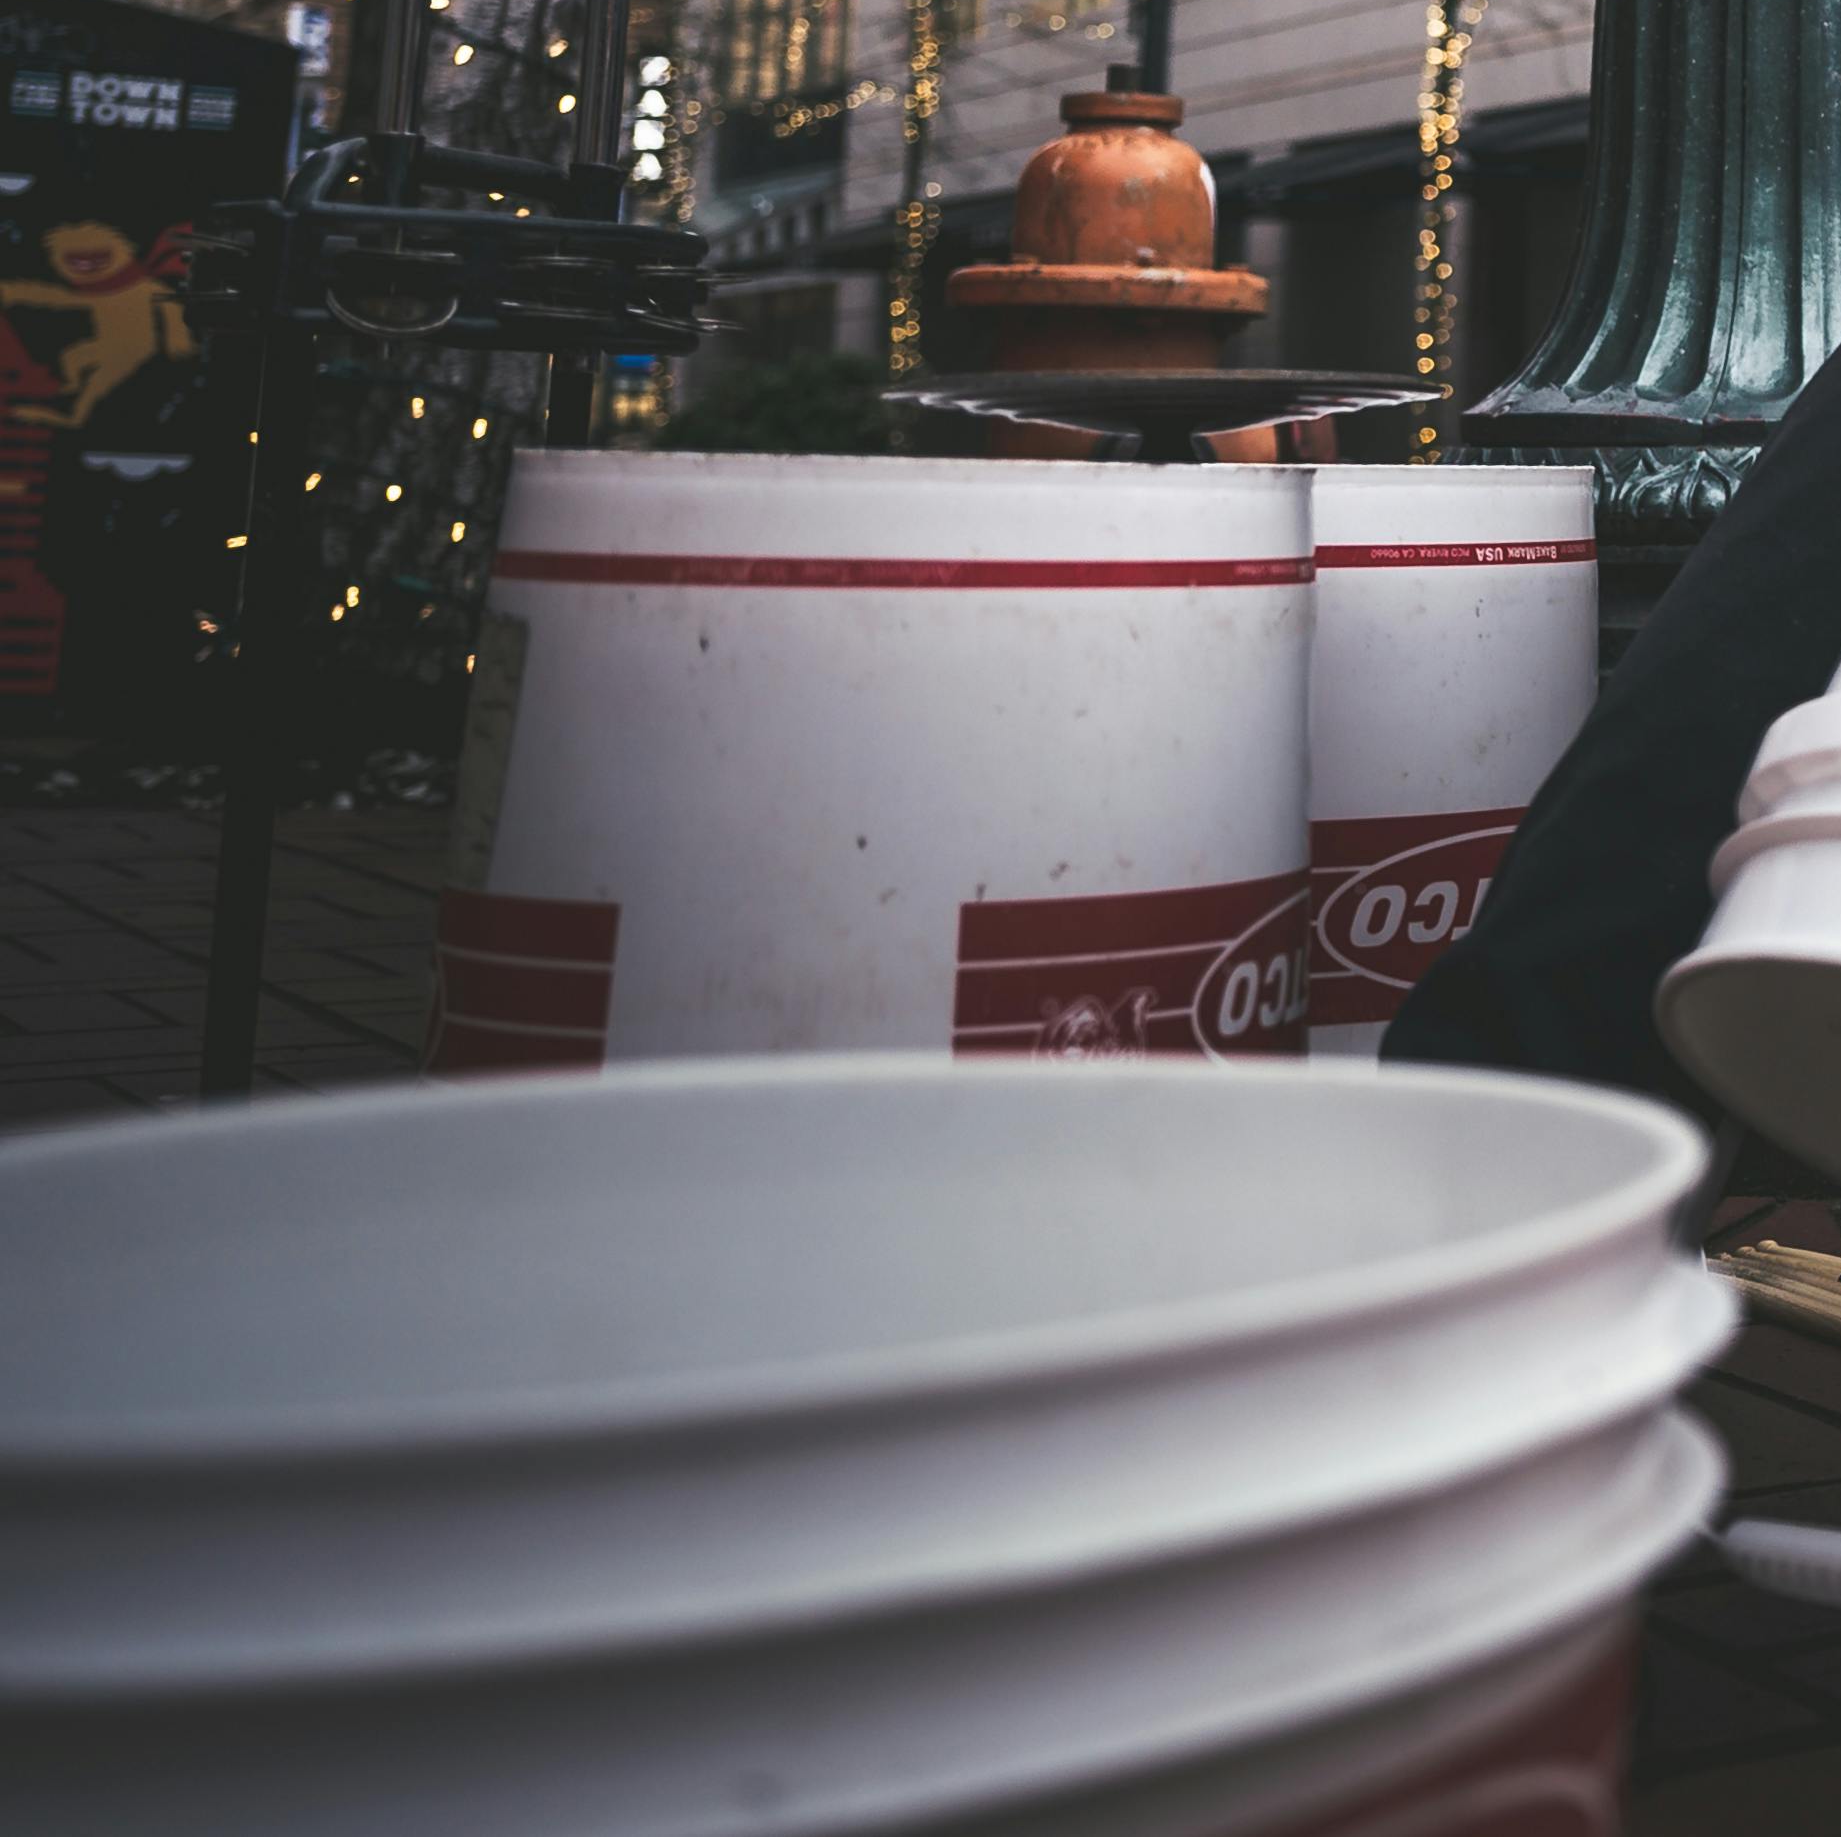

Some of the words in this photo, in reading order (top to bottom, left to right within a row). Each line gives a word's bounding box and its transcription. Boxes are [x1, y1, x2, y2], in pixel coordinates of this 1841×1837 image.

[70, 71, 182, 100] DOWN
[70, 100, 179, 130] TOWN
[1371, 548, 1400, 559] 90660
[1402, 549, 1414, 558] CA
[1451, 548, 1470, 557] PICO
[1475, 546, 1504, 562] USA
